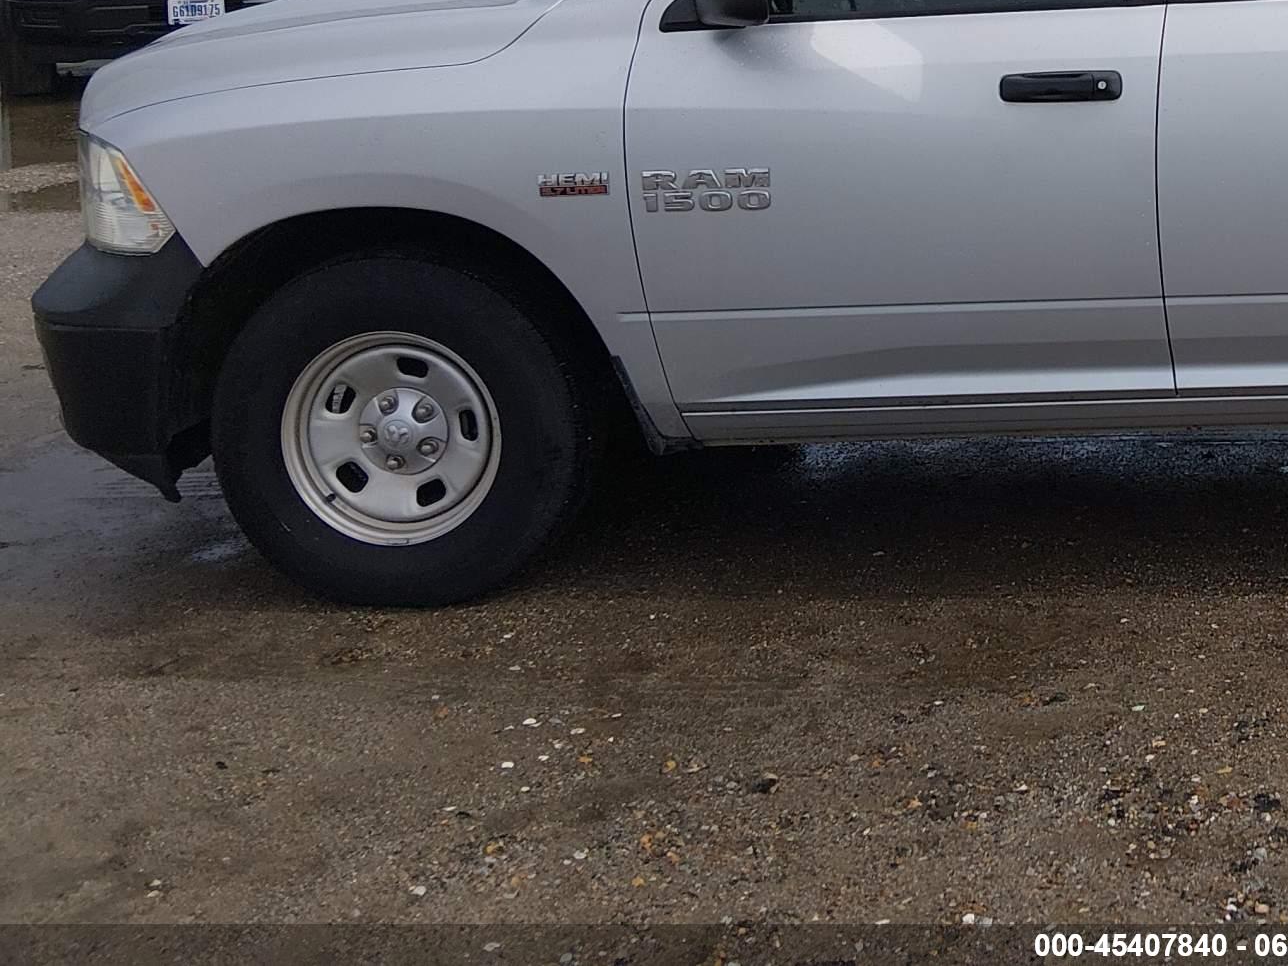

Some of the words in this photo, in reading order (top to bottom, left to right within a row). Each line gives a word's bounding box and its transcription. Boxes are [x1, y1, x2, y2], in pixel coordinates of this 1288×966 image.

[537, 172, 608, 186] HEMI
[641, 167, 771, 190] RAM
[642, 190, 772, 213] 1500
